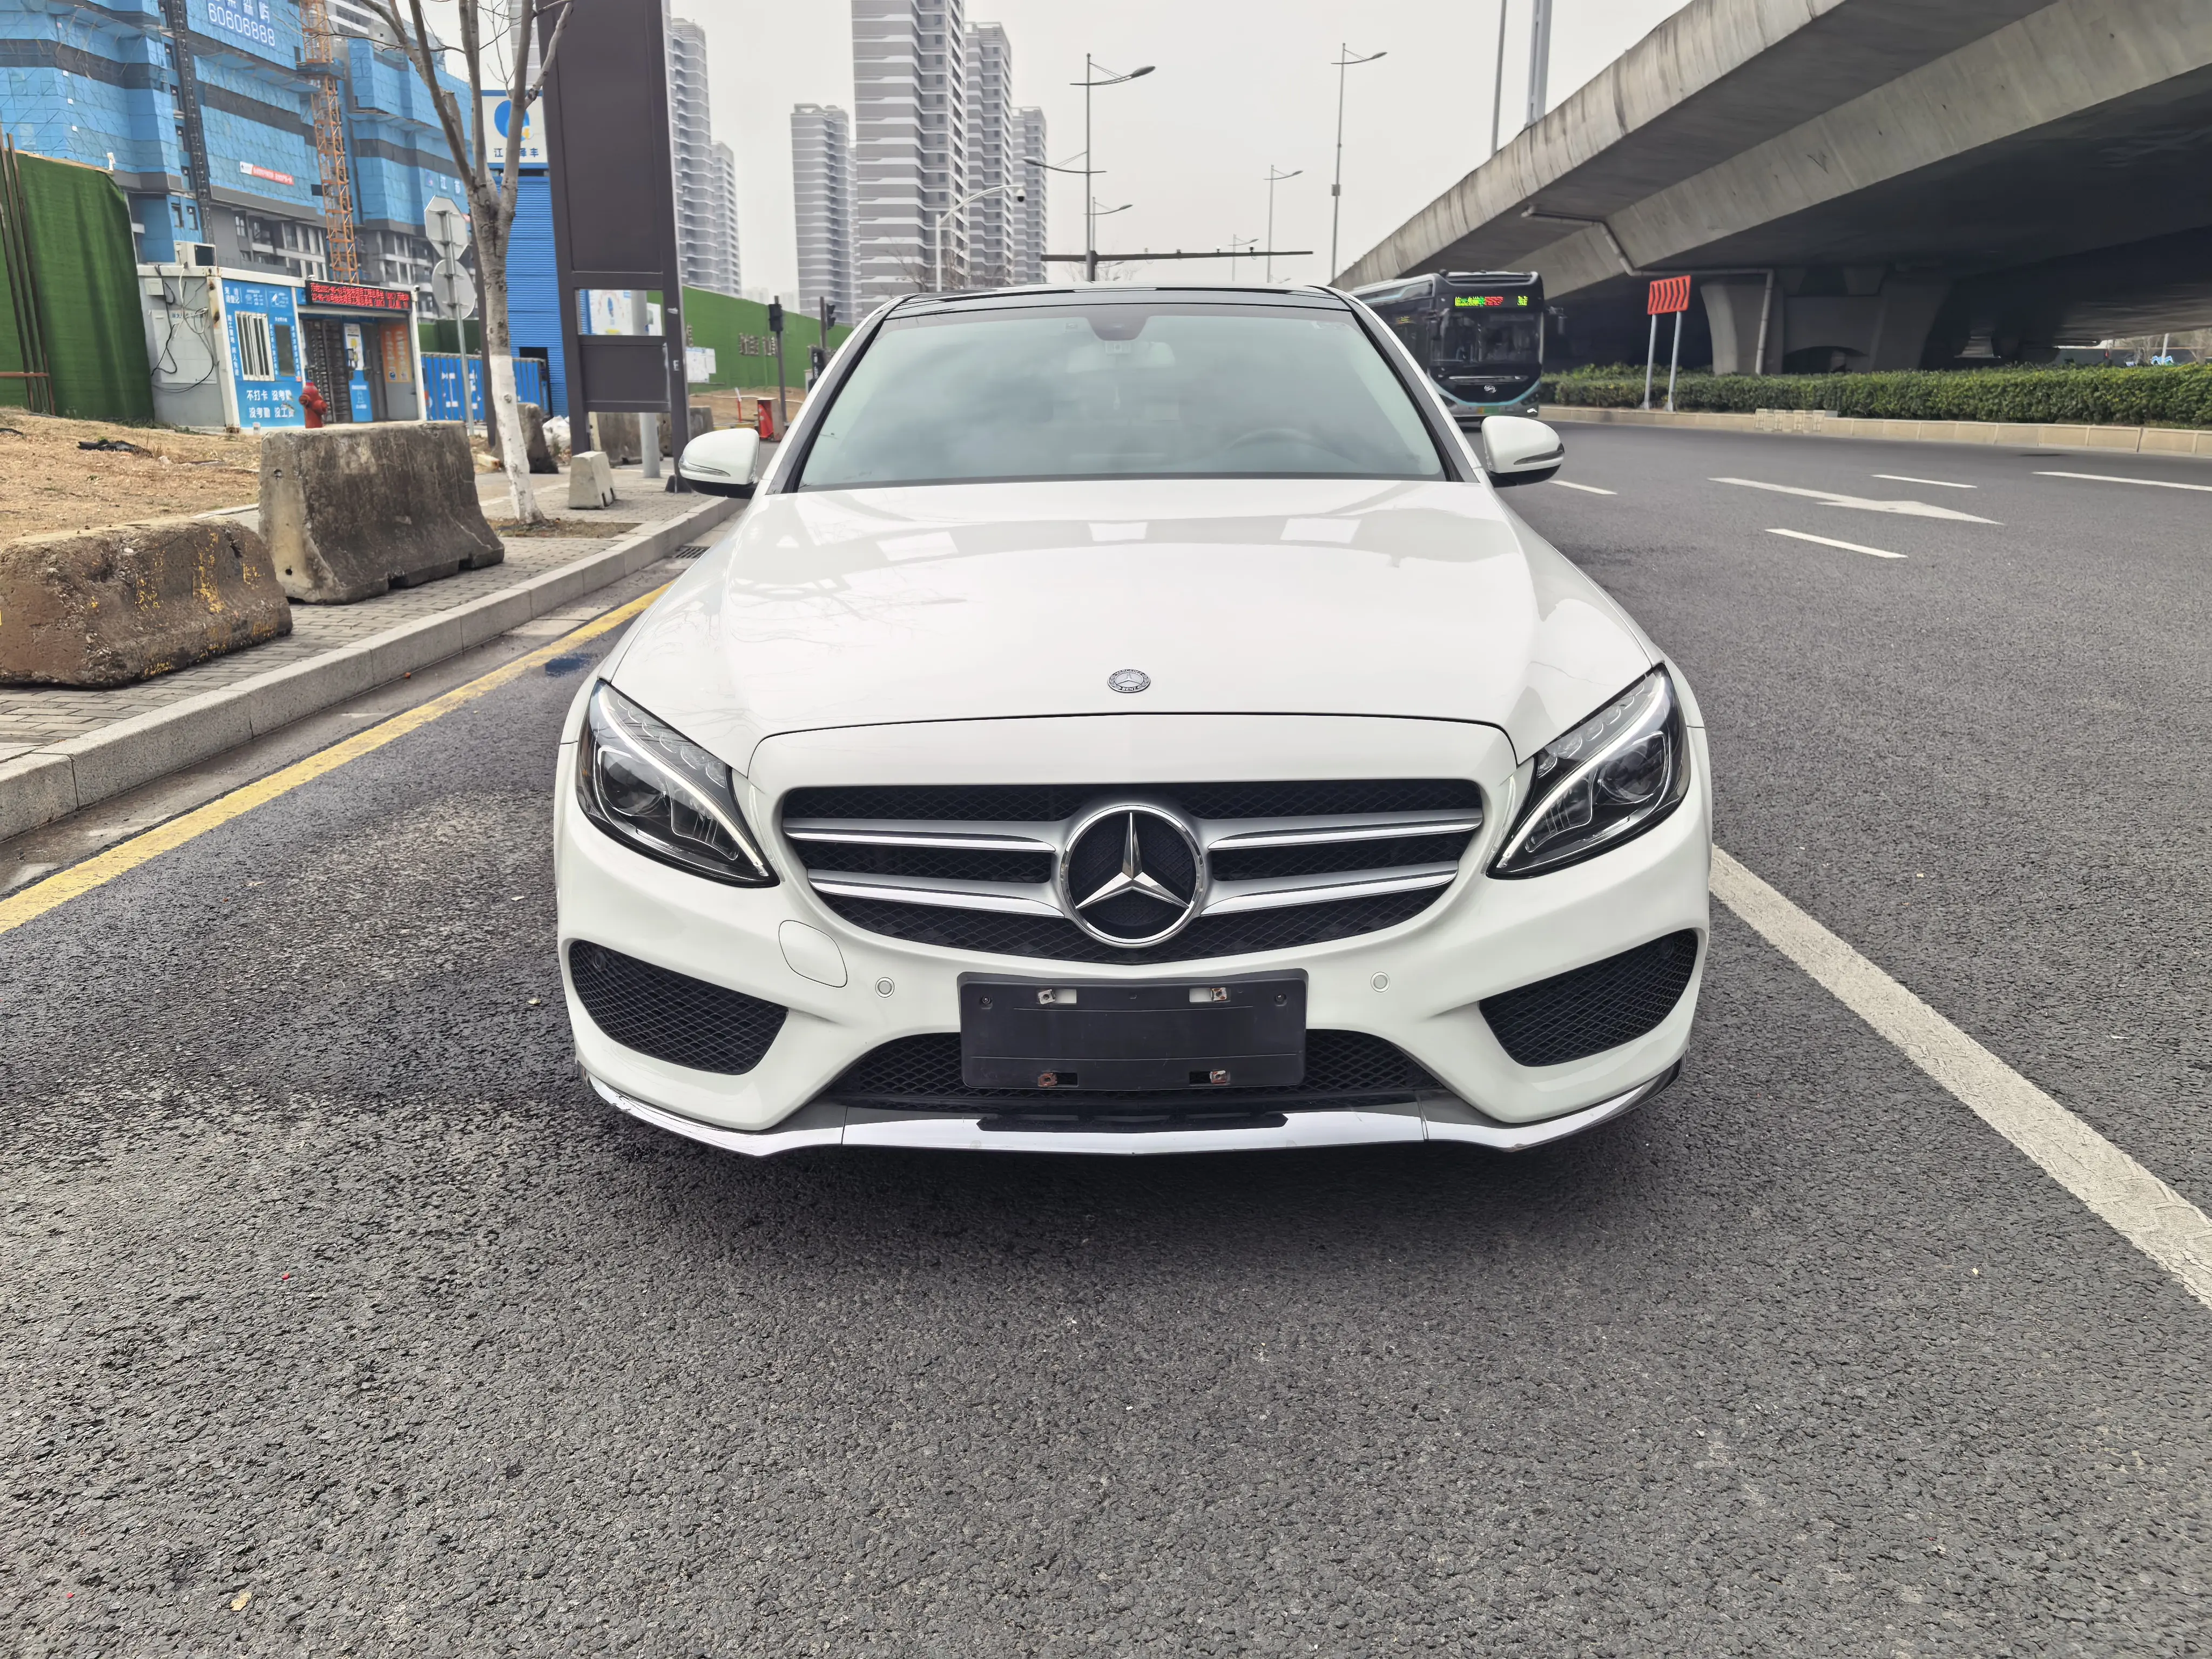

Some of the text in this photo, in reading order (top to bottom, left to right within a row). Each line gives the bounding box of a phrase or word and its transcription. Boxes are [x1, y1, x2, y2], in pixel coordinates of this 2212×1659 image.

[208, 3, 275, 46] 60606888
[246, 390, 268, 401] 不打卡
